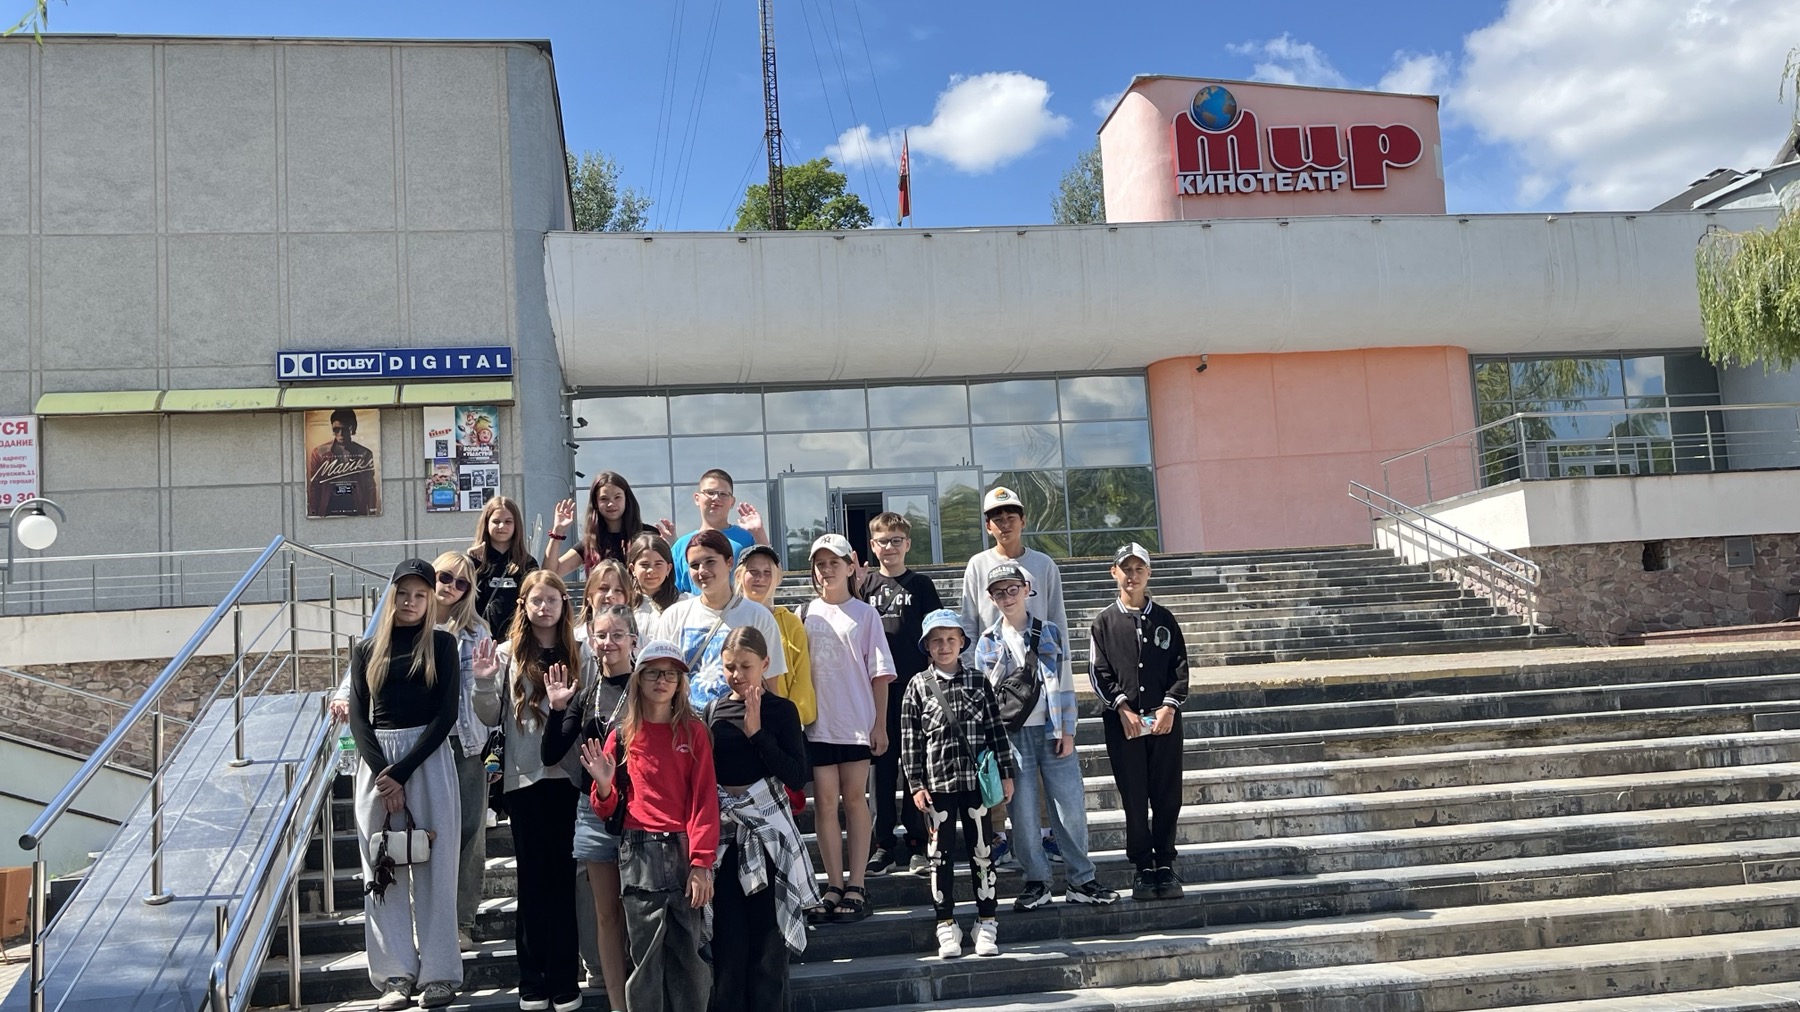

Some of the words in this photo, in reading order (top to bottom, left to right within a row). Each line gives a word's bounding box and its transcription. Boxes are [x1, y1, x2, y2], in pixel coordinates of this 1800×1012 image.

[1178, 171, 1348, 194] КИНОТЕАТР
[327, 358, 375, 370] DOLBY
[389, 354, 508, 370] DIGITAL
[0, 421, 28, 435] СЯ
[869, 594, 912, 607] BLCK
